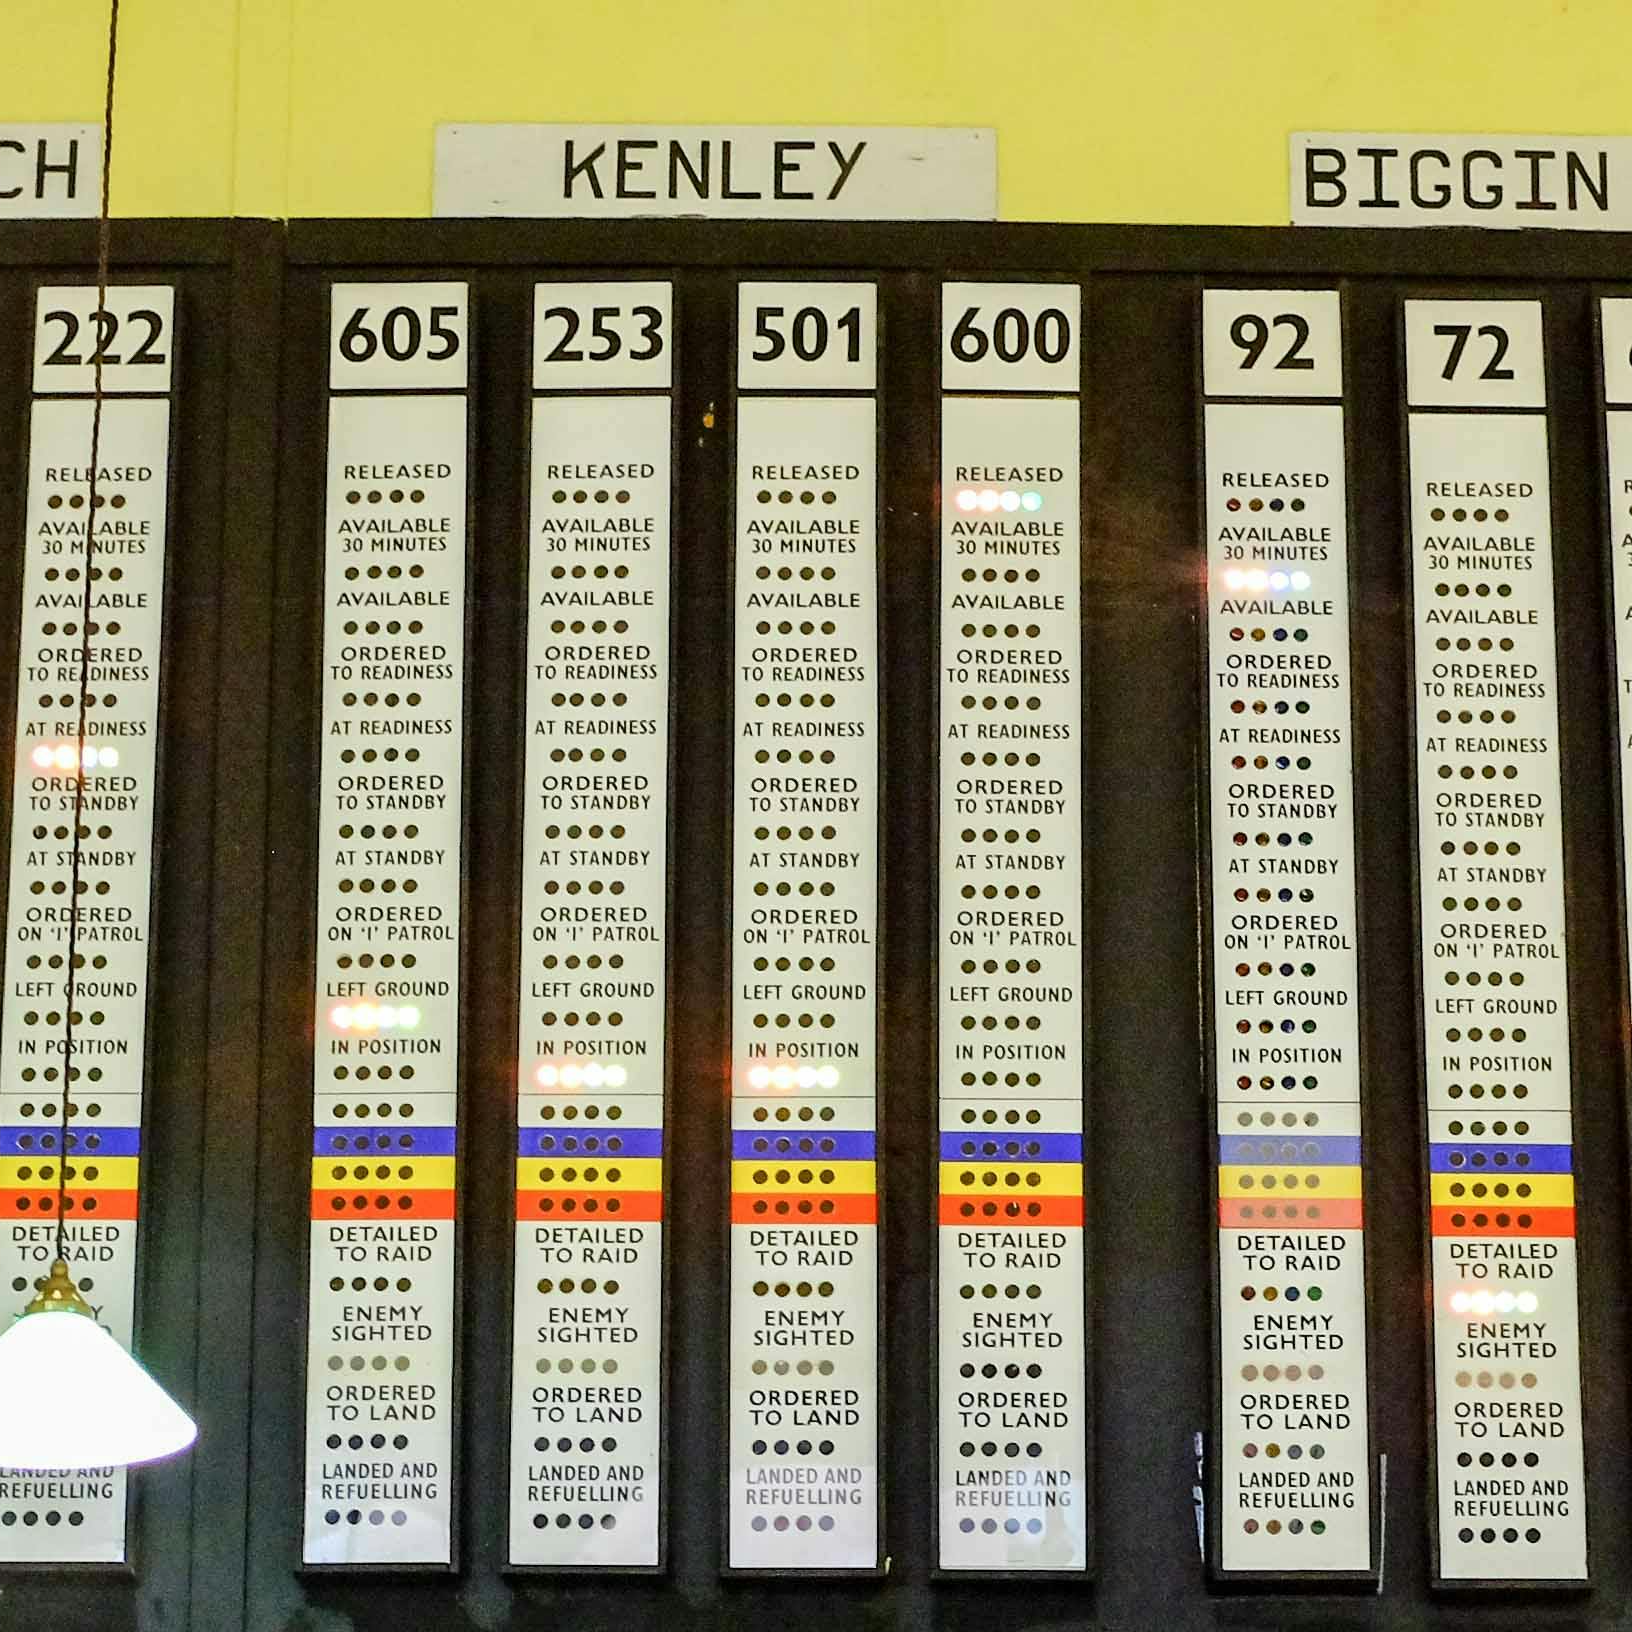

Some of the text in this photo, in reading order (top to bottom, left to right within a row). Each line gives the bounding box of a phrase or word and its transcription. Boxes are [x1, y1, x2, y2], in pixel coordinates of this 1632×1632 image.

[564, 140, 866, 200] KENLEY
[1306, 148, 1608, 211] BIGGIN
[43, 305, 165, 370] 222
[339, 306, 459, 362] 605
[544, 306, 663, 362] 253
[753, 307, 860, 362] 501
[951, 307, 1070, 363] 600
[1230, 314, 1314, 369] 92
[1434, 325, 1514, 380] 72
[345, 464, 451, 479] RELEASED
[338, 518, 449, 533] AVAILABLE
[344, 537, 446, 552] 30 MINUTES
[331, 664, 452, 680] TO READINESS
[341, 646, 446, 661] ORDERED
